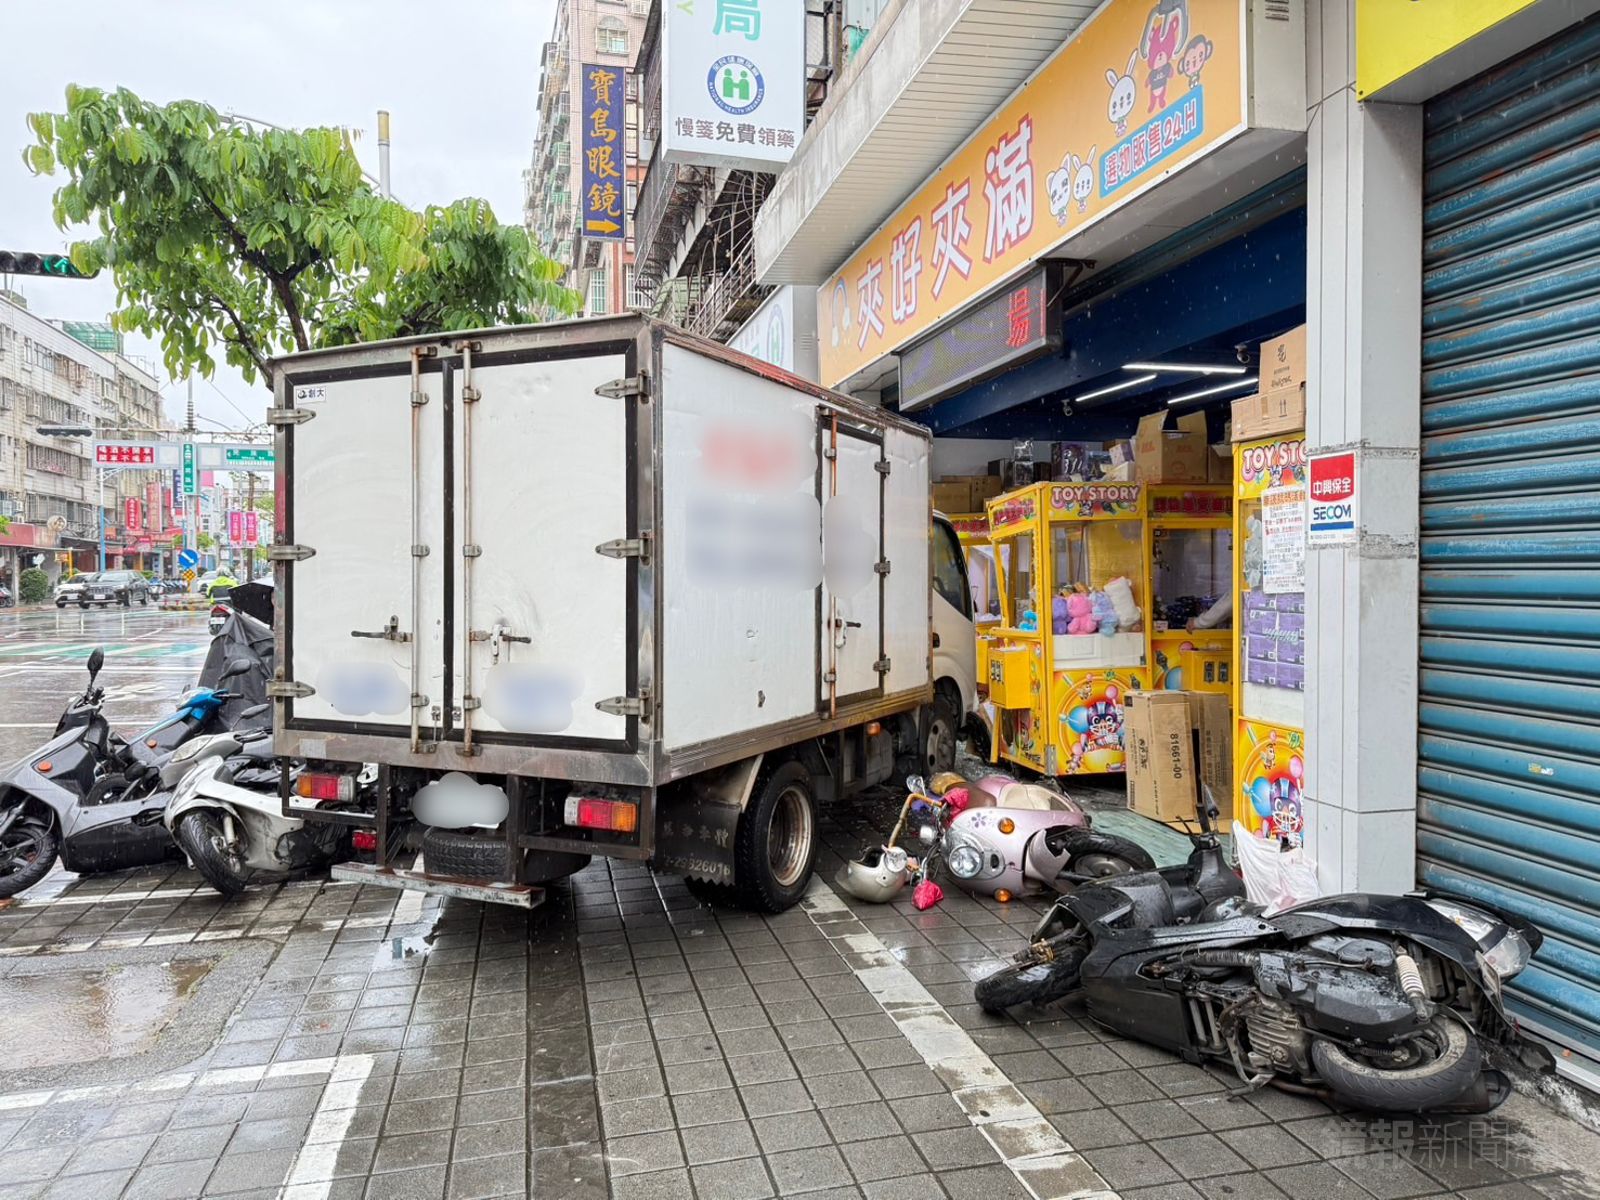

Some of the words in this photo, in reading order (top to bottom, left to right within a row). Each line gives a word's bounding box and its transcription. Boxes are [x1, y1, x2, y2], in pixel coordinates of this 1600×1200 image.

[586, 69, 621, 218] 寶島眼鏡
[675, 116, 795, 149] 慢箋免費領藥
[1104, 97, 1197, 190] 選物販售24H
[857, 112, 1034, 351] 夾好夾滿
[1243, 446, 1276, 472] TOY
[1051, 486, 1083, 501] TOY
[1088, 485, 1140, 501] STORY
[1312, 476, 1352, 496] 中興保全
[1313, 503, 1352, 521] SECOM
[1169, 733, 1182, 780] 81661-00
